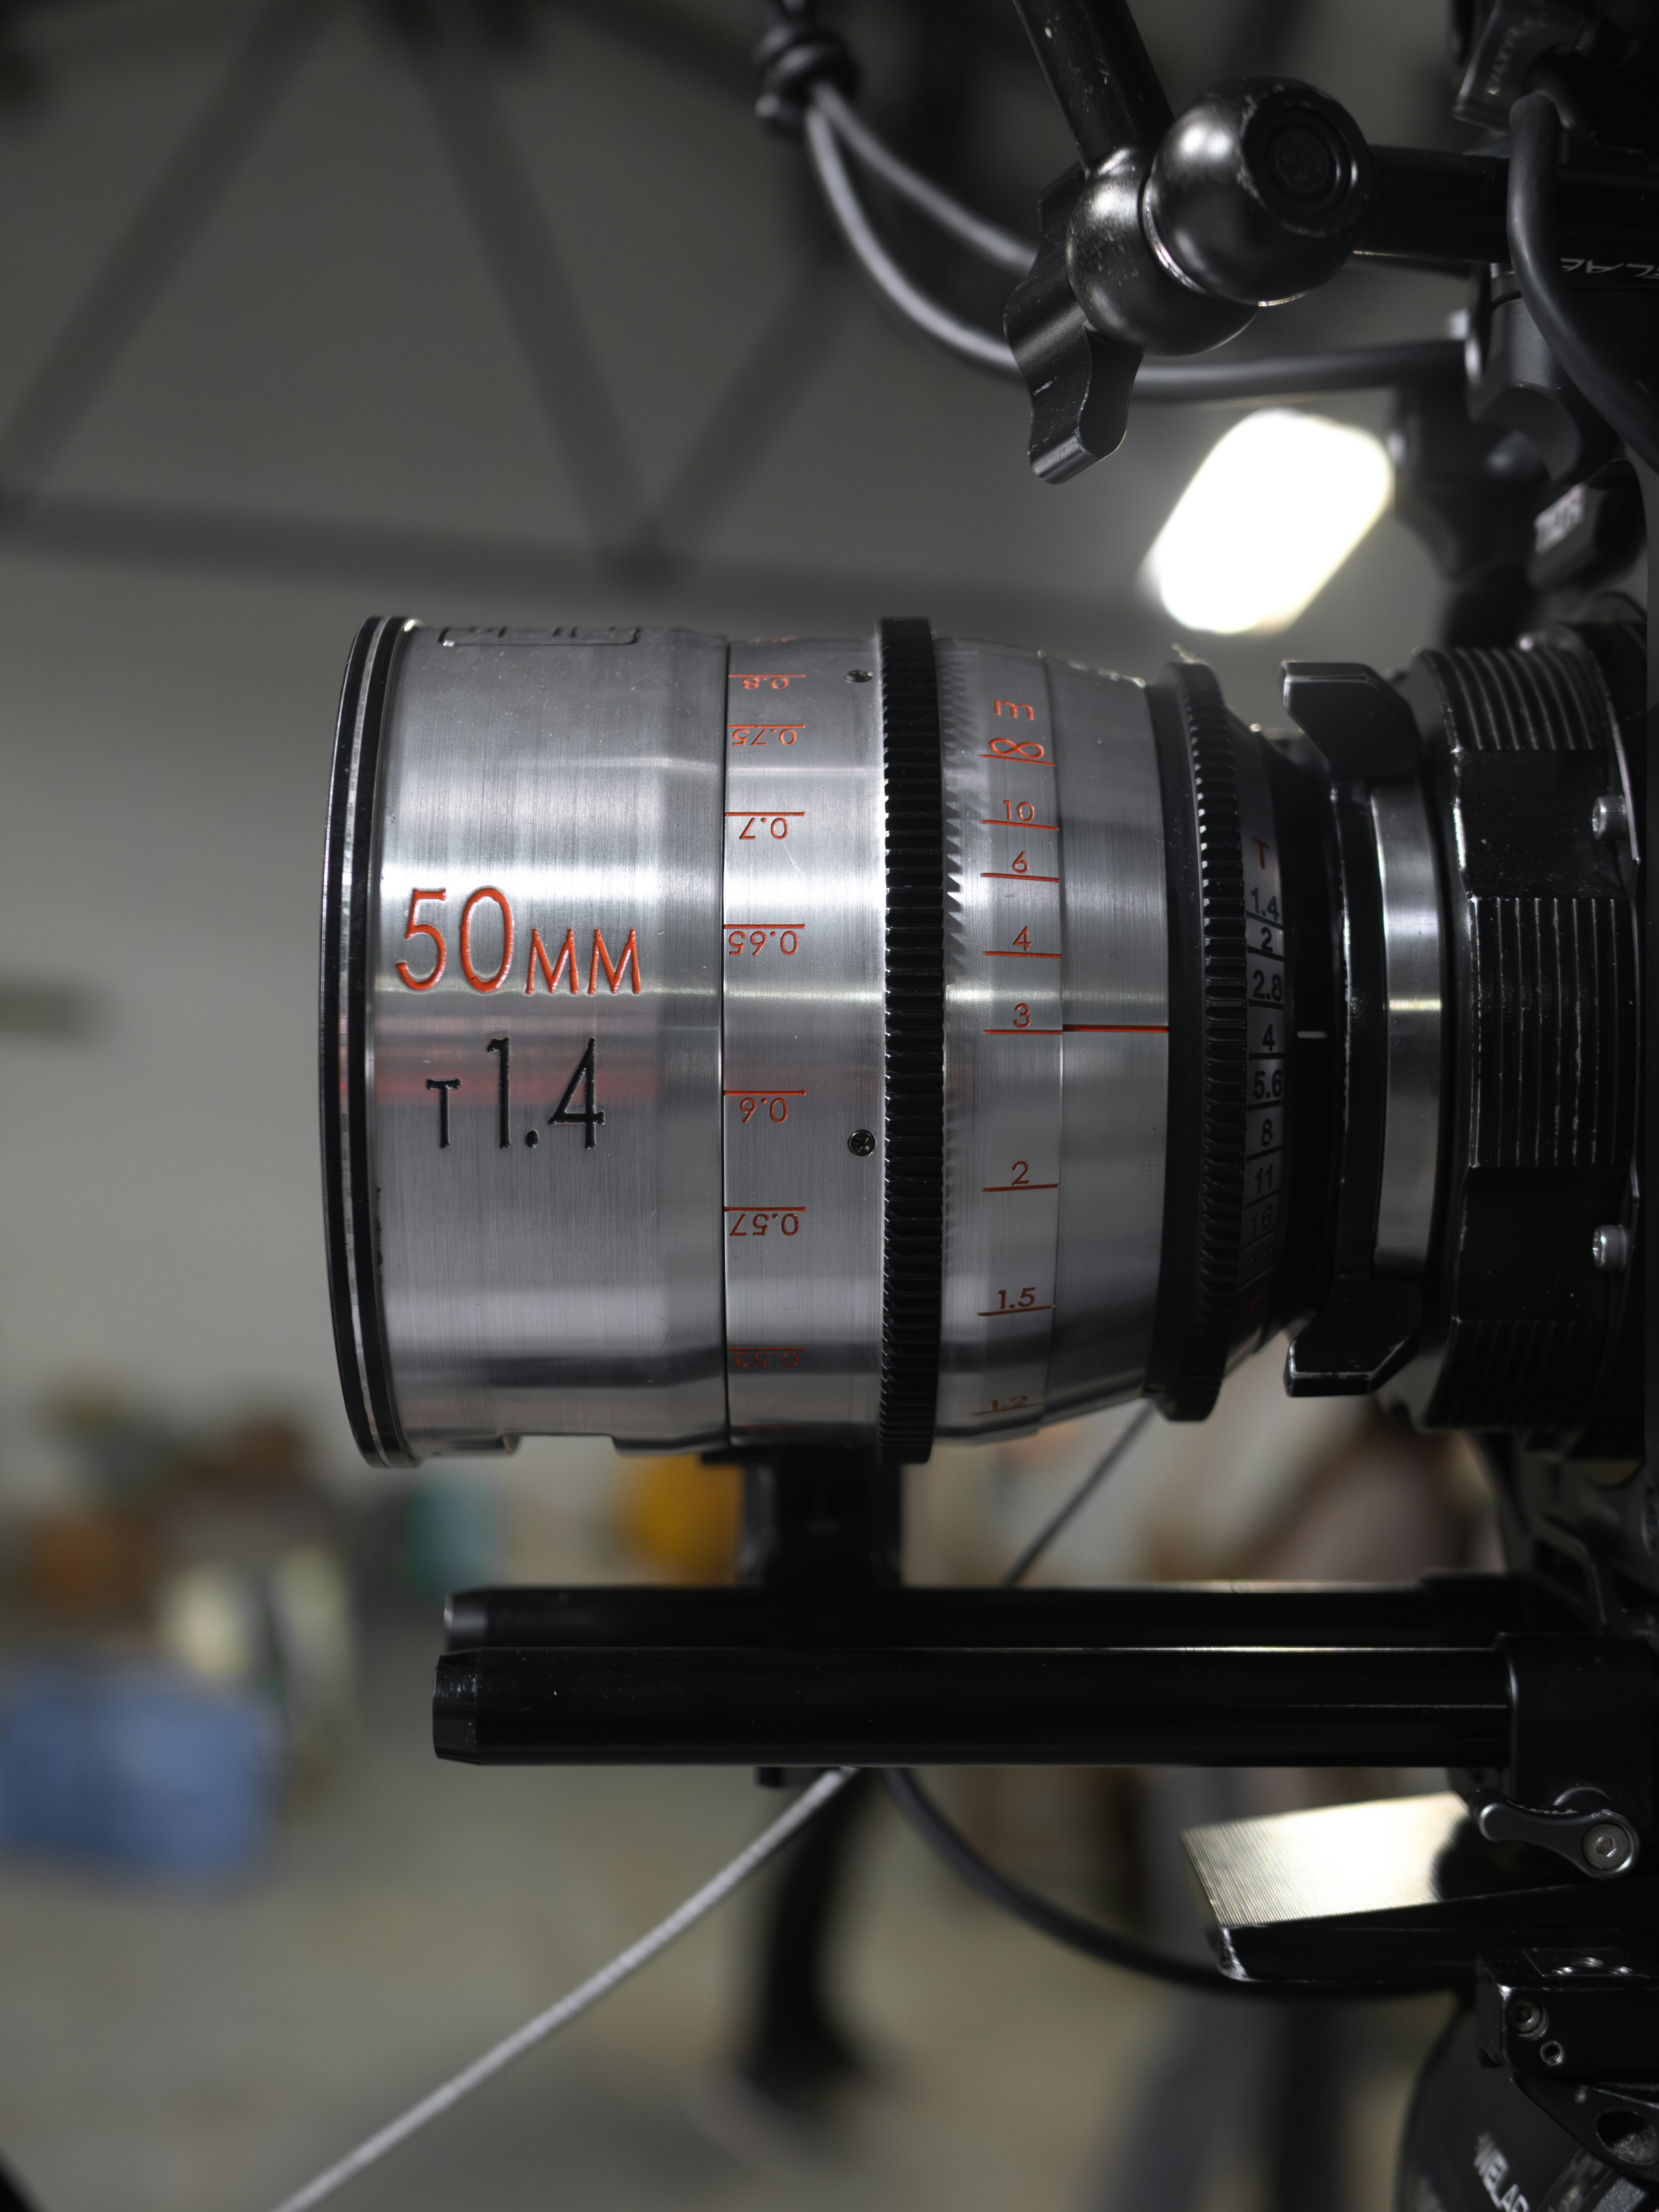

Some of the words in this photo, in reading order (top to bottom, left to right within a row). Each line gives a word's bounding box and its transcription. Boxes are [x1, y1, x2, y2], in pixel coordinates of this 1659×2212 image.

[743, 677, 789, 690] 0.8
[993, 700, 1034, 721] m
[732, 728, 797, 746] 0.75
[1003, 800, 1035, 823] 10
[739, 817, 788, 840] 0.7
[1012, 850, 1029, 874] 6
[1253, 836, 1270, 870] T
[1250, 887, 1280, 922] 1.4
[395, 887, 641, 995] 50MM
[728, 930, 799, 956] 0.65
[1012, 926, 1032, 951] 4
[1260, 926, 1273, 952] 2
[1253, 969, 1282, 1002] 2.8
[1013, 1002, 1031, 1029] 3
[1262, 1023, 1276, 1052] 4
[1253, 1068, 1283, 1100] 5.6
[739, 1097, 788, 1123] 0.6
[1260, 1118, 1274, 1148] 8
[1010, 1160, 1030, 1186] 2
[1254, 1162, 1274, 1194] 11
[729, 1213, 800, 1236] 0.57
[1250, 1205, 1274, 1236] 16
[997, 1286, 1036, 1310] 1.5
[732, 1351, 799, 1369] 0.53
